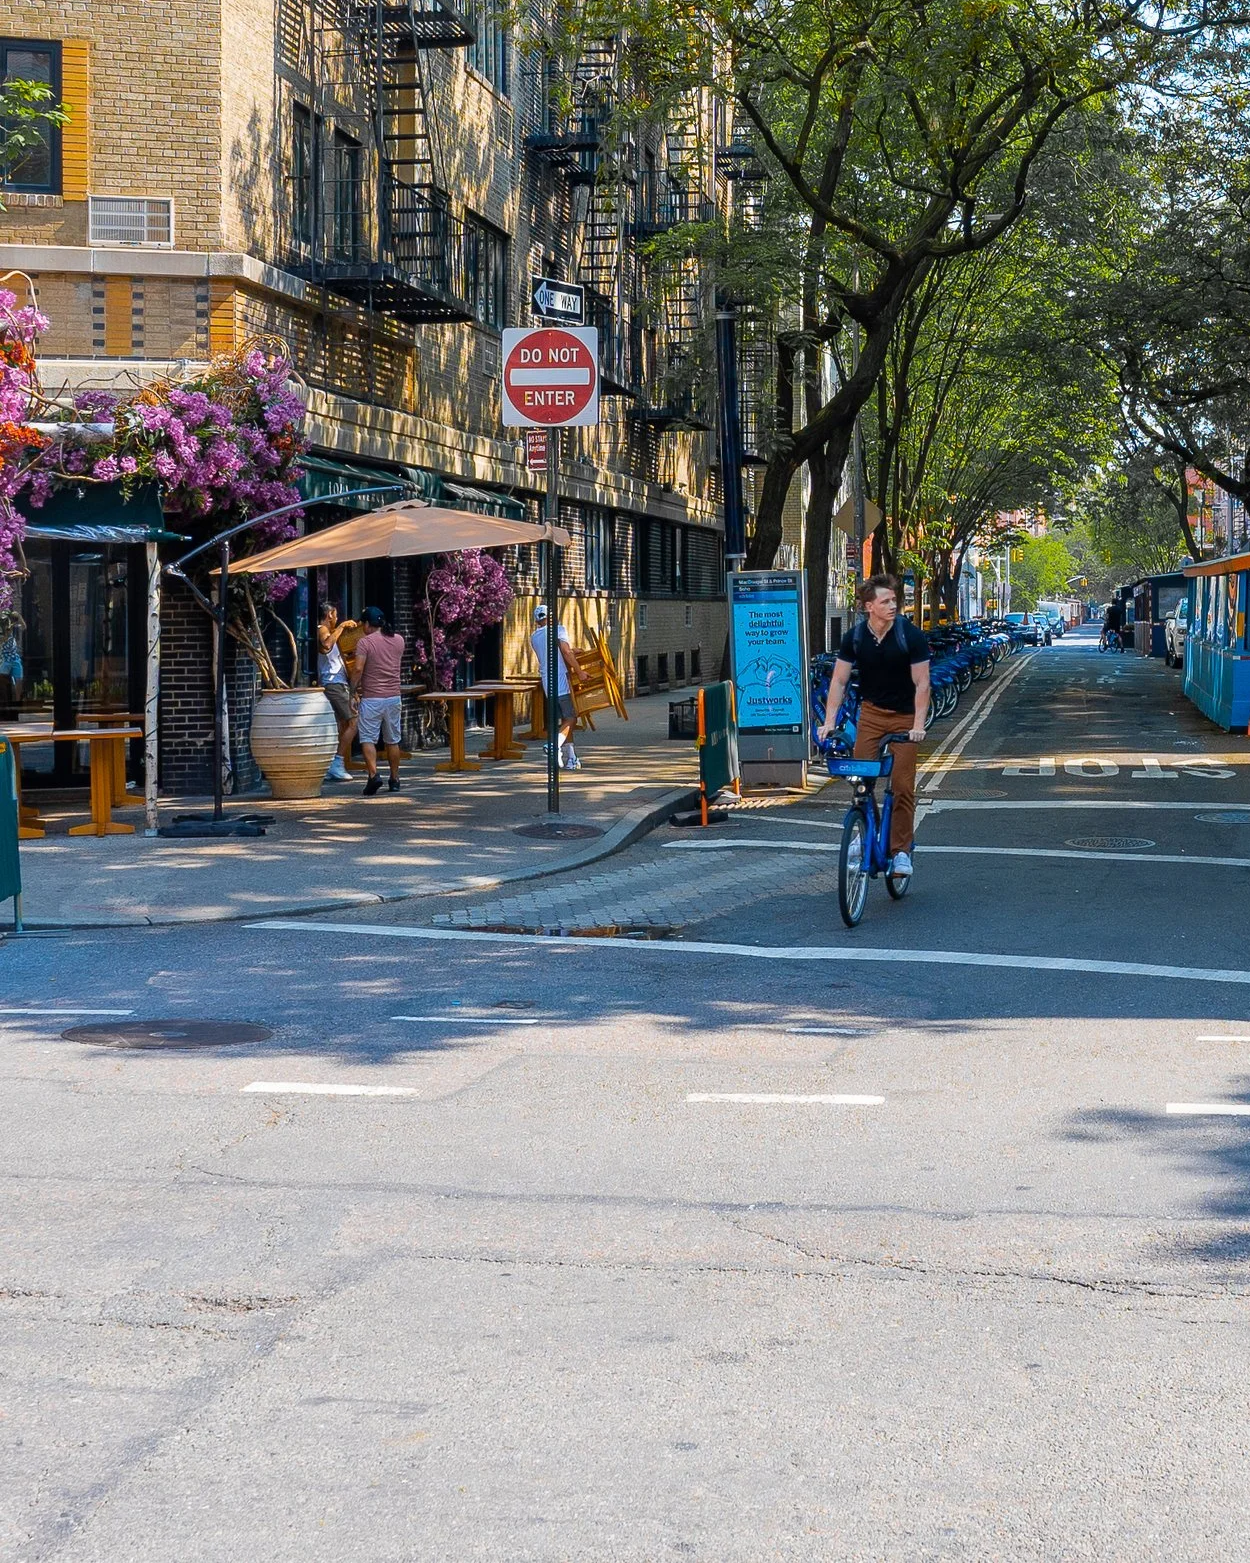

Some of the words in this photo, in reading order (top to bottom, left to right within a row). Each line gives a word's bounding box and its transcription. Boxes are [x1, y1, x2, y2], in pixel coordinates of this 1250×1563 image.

[539, 289, 555, 307] ONE
[560, 295, 578, 312] WAY
[520, 348, 542, 364] DO
[548, 347, 580, 363] NOT
[524, 390, 576, 406] ENTER
[748, 620, 785, 628] delightful
[770, 630, 789, 638] grow
[746, 695, 793, 705] Justworks
[1001, 757, 1237, 779] STOP
